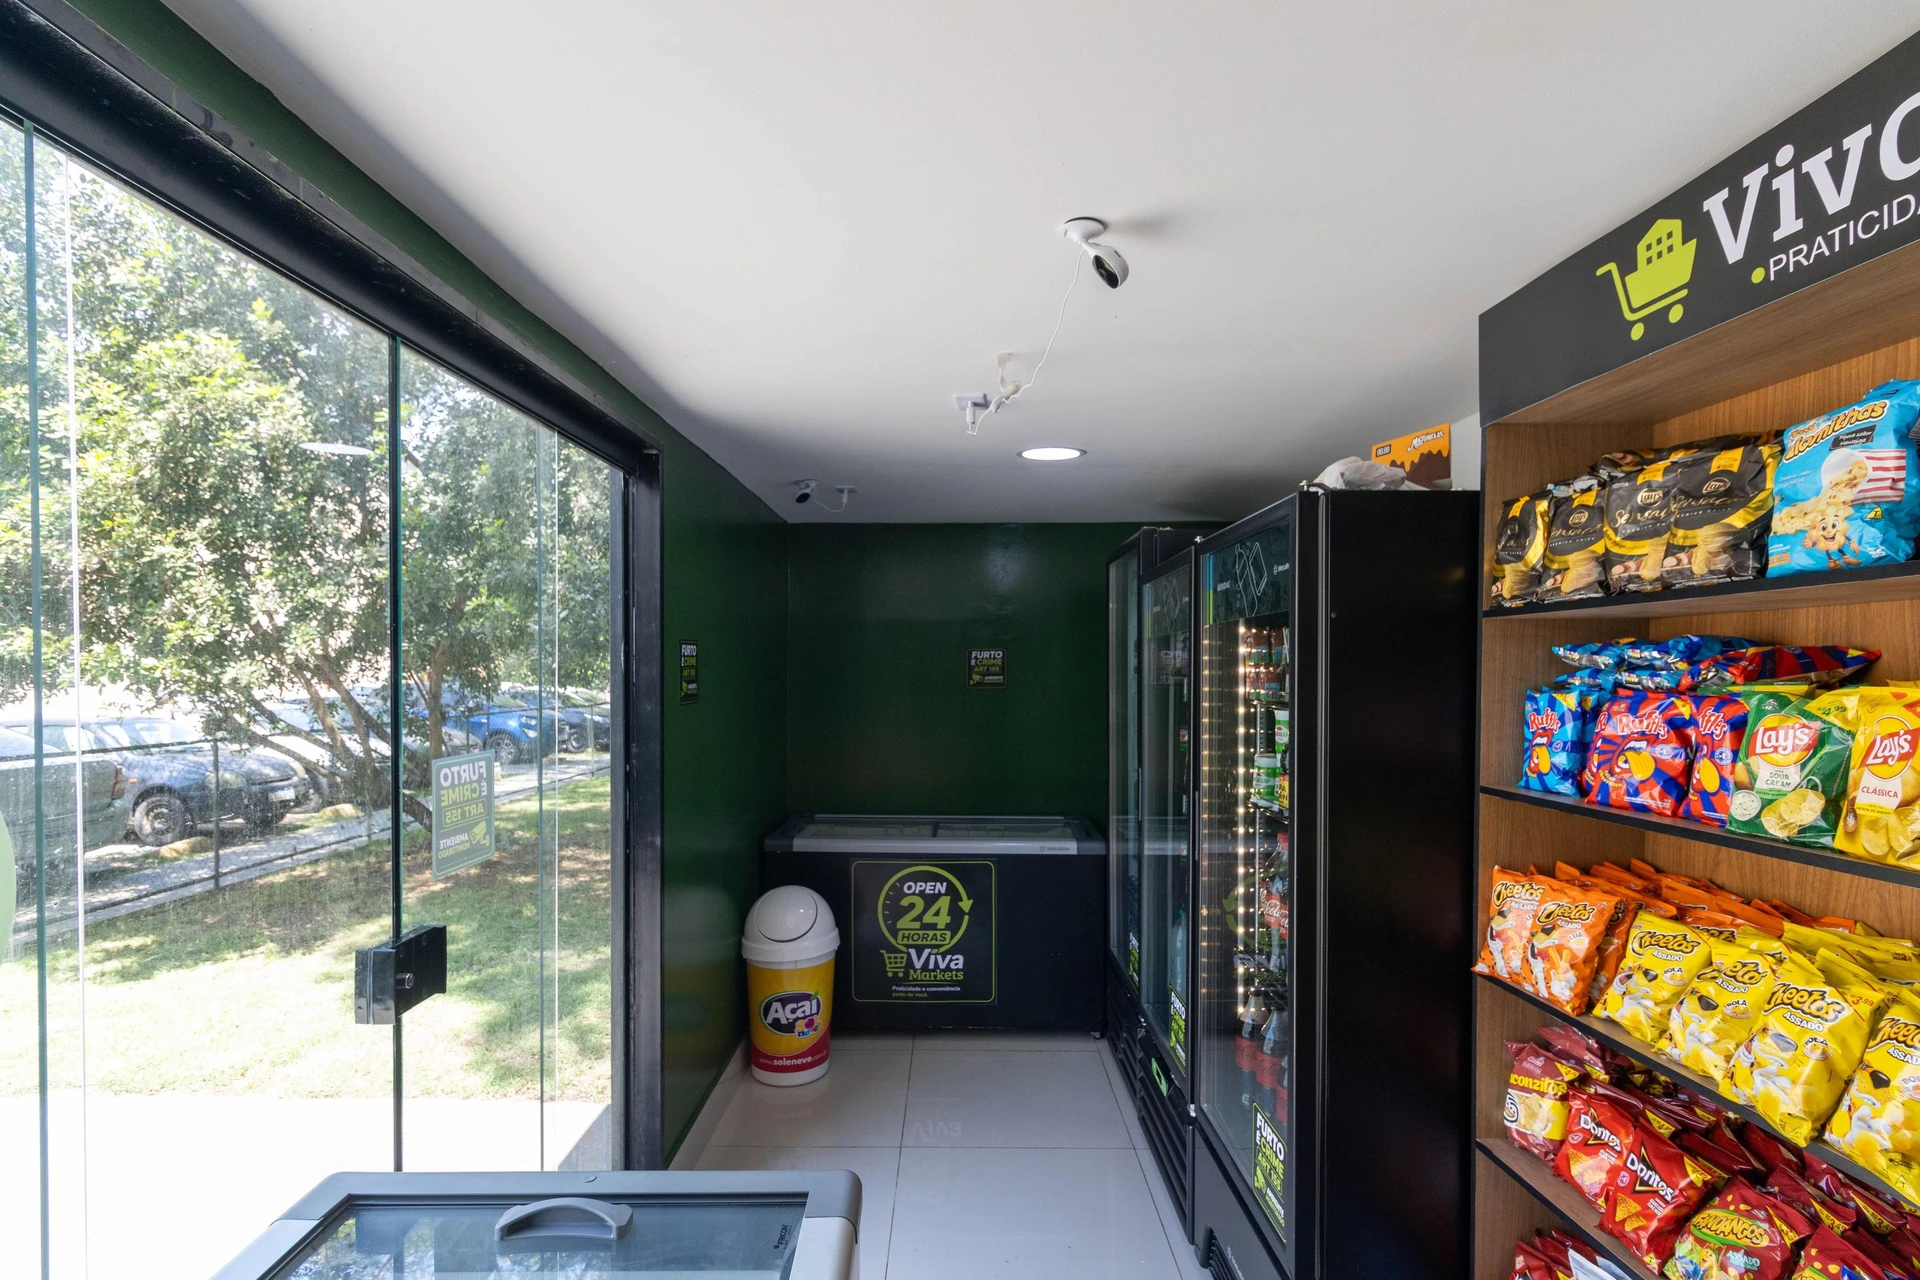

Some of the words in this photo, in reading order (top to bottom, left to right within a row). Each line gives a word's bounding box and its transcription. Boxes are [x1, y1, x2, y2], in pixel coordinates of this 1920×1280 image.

[1769, 194, 1920, 282] PRATICID
[682, 644, 697, 656] FURTO
[971, 651, 1003, 659] FURTO
[1755, 723, 1810, 756] Lay's
[1866, 729, 1912, 766] Lay's
[1765, 779, 1791, 788] CREAM
[1769, 771, 1789, 780] SOUR
[1861, 784, 1898, 799] CLÁSSICA
[903, 881, 947, 894] OPEN
[1493, 881, 1545, 908] Cheetos
[896, 895, 951, 929] 24
[1511, 901, 1537, 911] ASSADO
[1537, 902, 1597, 924] Cheetos
[1557, 920, 1582, 929] ASSADO
[901, 933, 947, 942] HORAS
[1568, 932, 1583, 941] LUA
[1631, 931, 1702, 957] Cheetos
[908, 948, 964, 969] Viva
[1652, 950, 1684, 962] ASSADO
[908, 969, 964, 980] Markets
[1715, 978, 1748, 994] ASSADO
[1171, 990, 1186, 1020] FURTO
[1784, 1011, 1825, 1033] ASSADO
[1887, 1046, 1920, 1065] ASSAD
[1257, 1112, 1284, 1160] FURTO
[1580, 1114, 1622, 1152] Doritos
[1257, 1152, 1270, 1173] ART
[1260, 1137, 1284, 1180] CRIME
[1626, 1152, 1675, 1203] Doritos
[776, 1224, 790, 1245] FRICON
[1726, 1250, 1760, 1267] ASSADO
